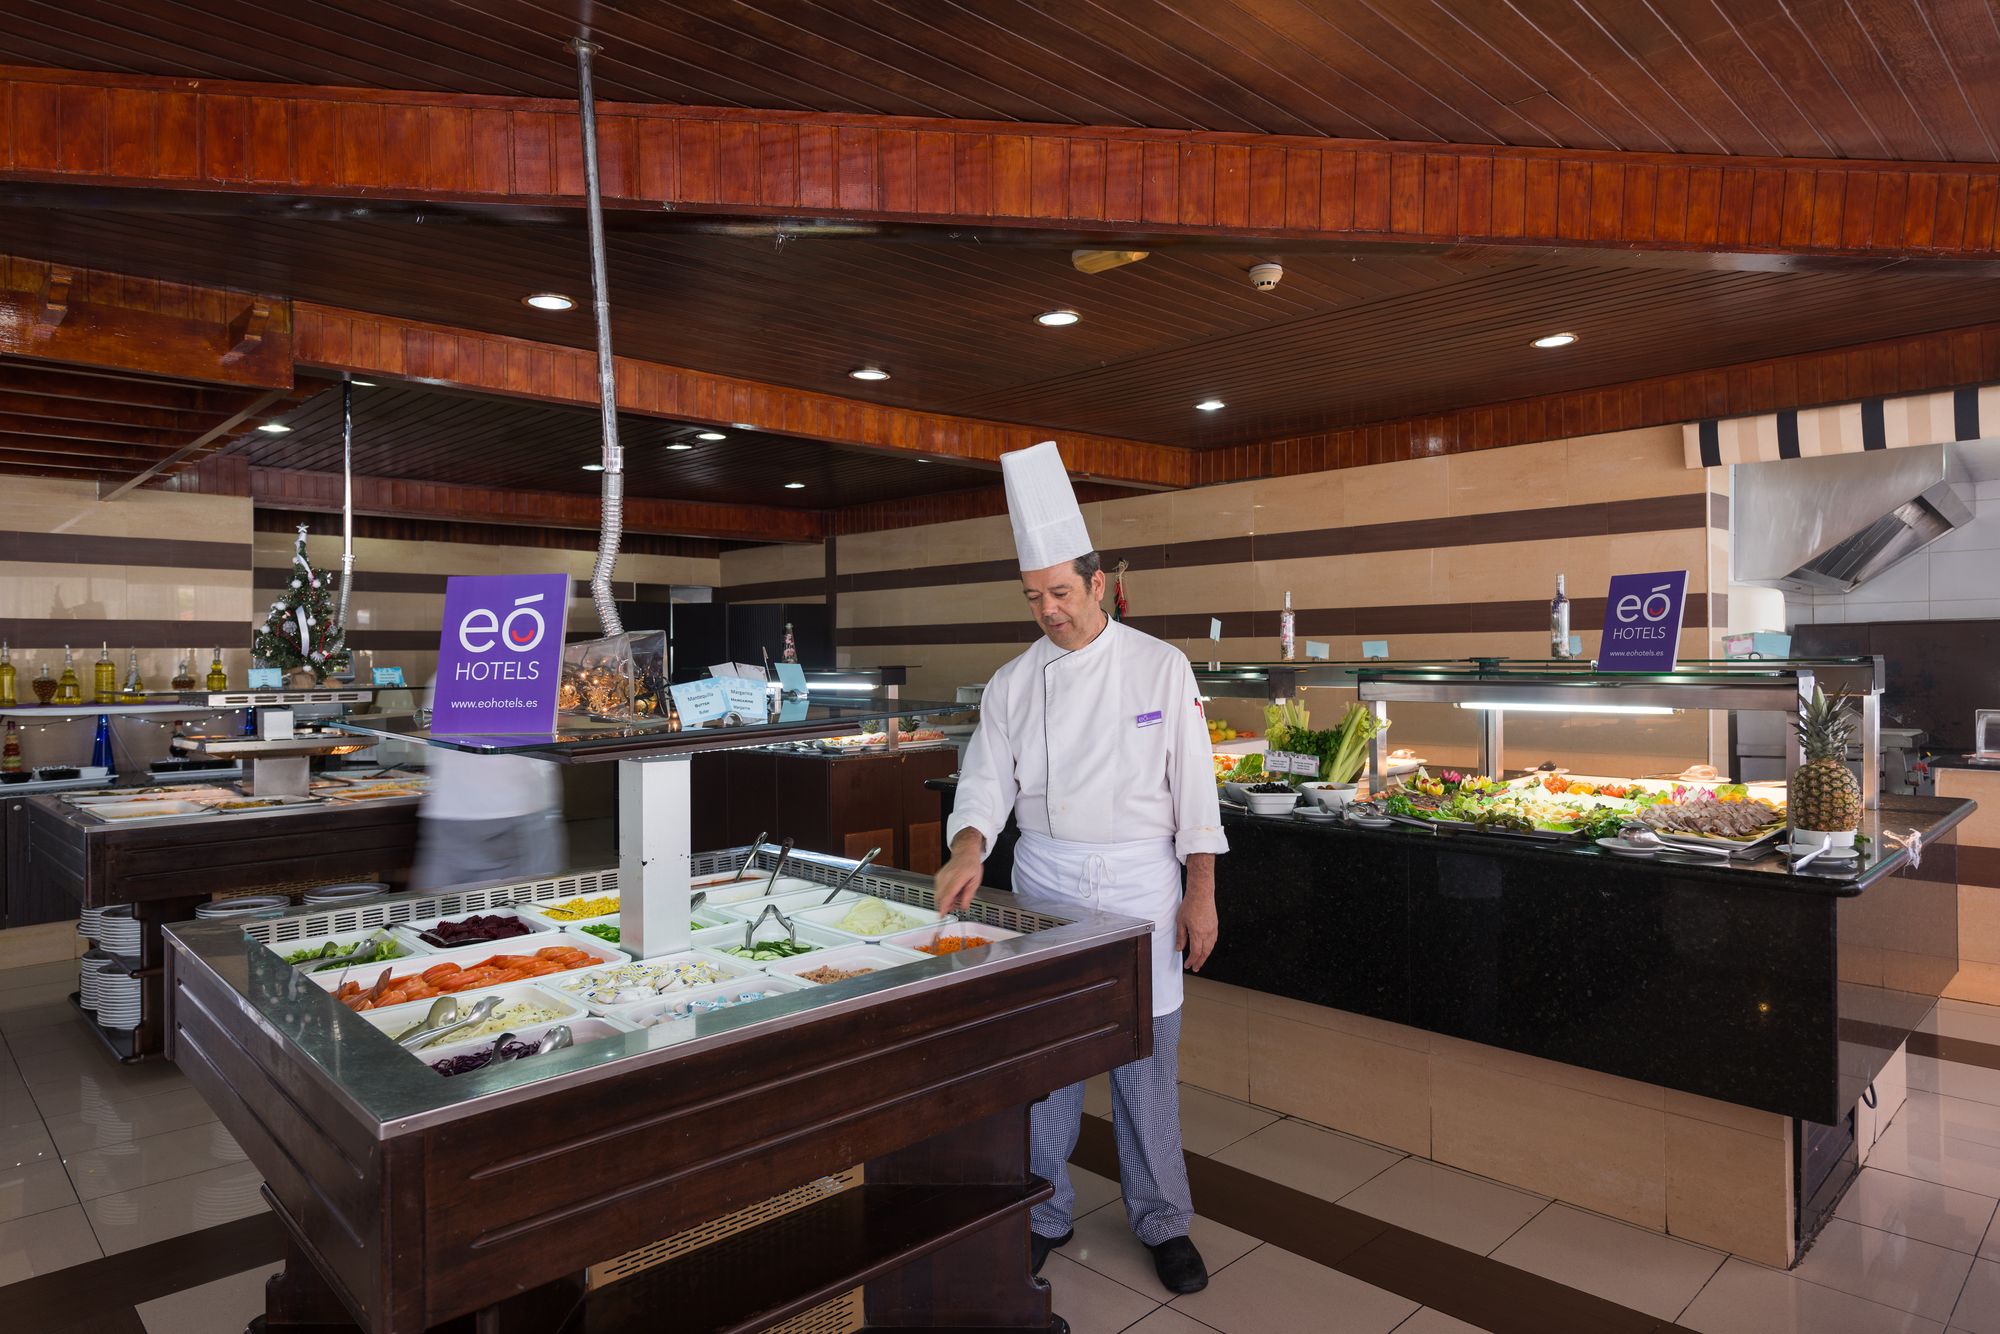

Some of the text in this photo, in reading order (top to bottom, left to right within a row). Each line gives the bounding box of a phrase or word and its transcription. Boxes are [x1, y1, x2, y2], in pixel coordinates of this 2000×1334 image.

[1613, 626, 1666, 640] HOTELS
[1609, 649, 1664, 657] www.eohotels.es
[455, 660, 540, 681] HOTELS
[450, 697, 538, 709] www.eohotels.es
